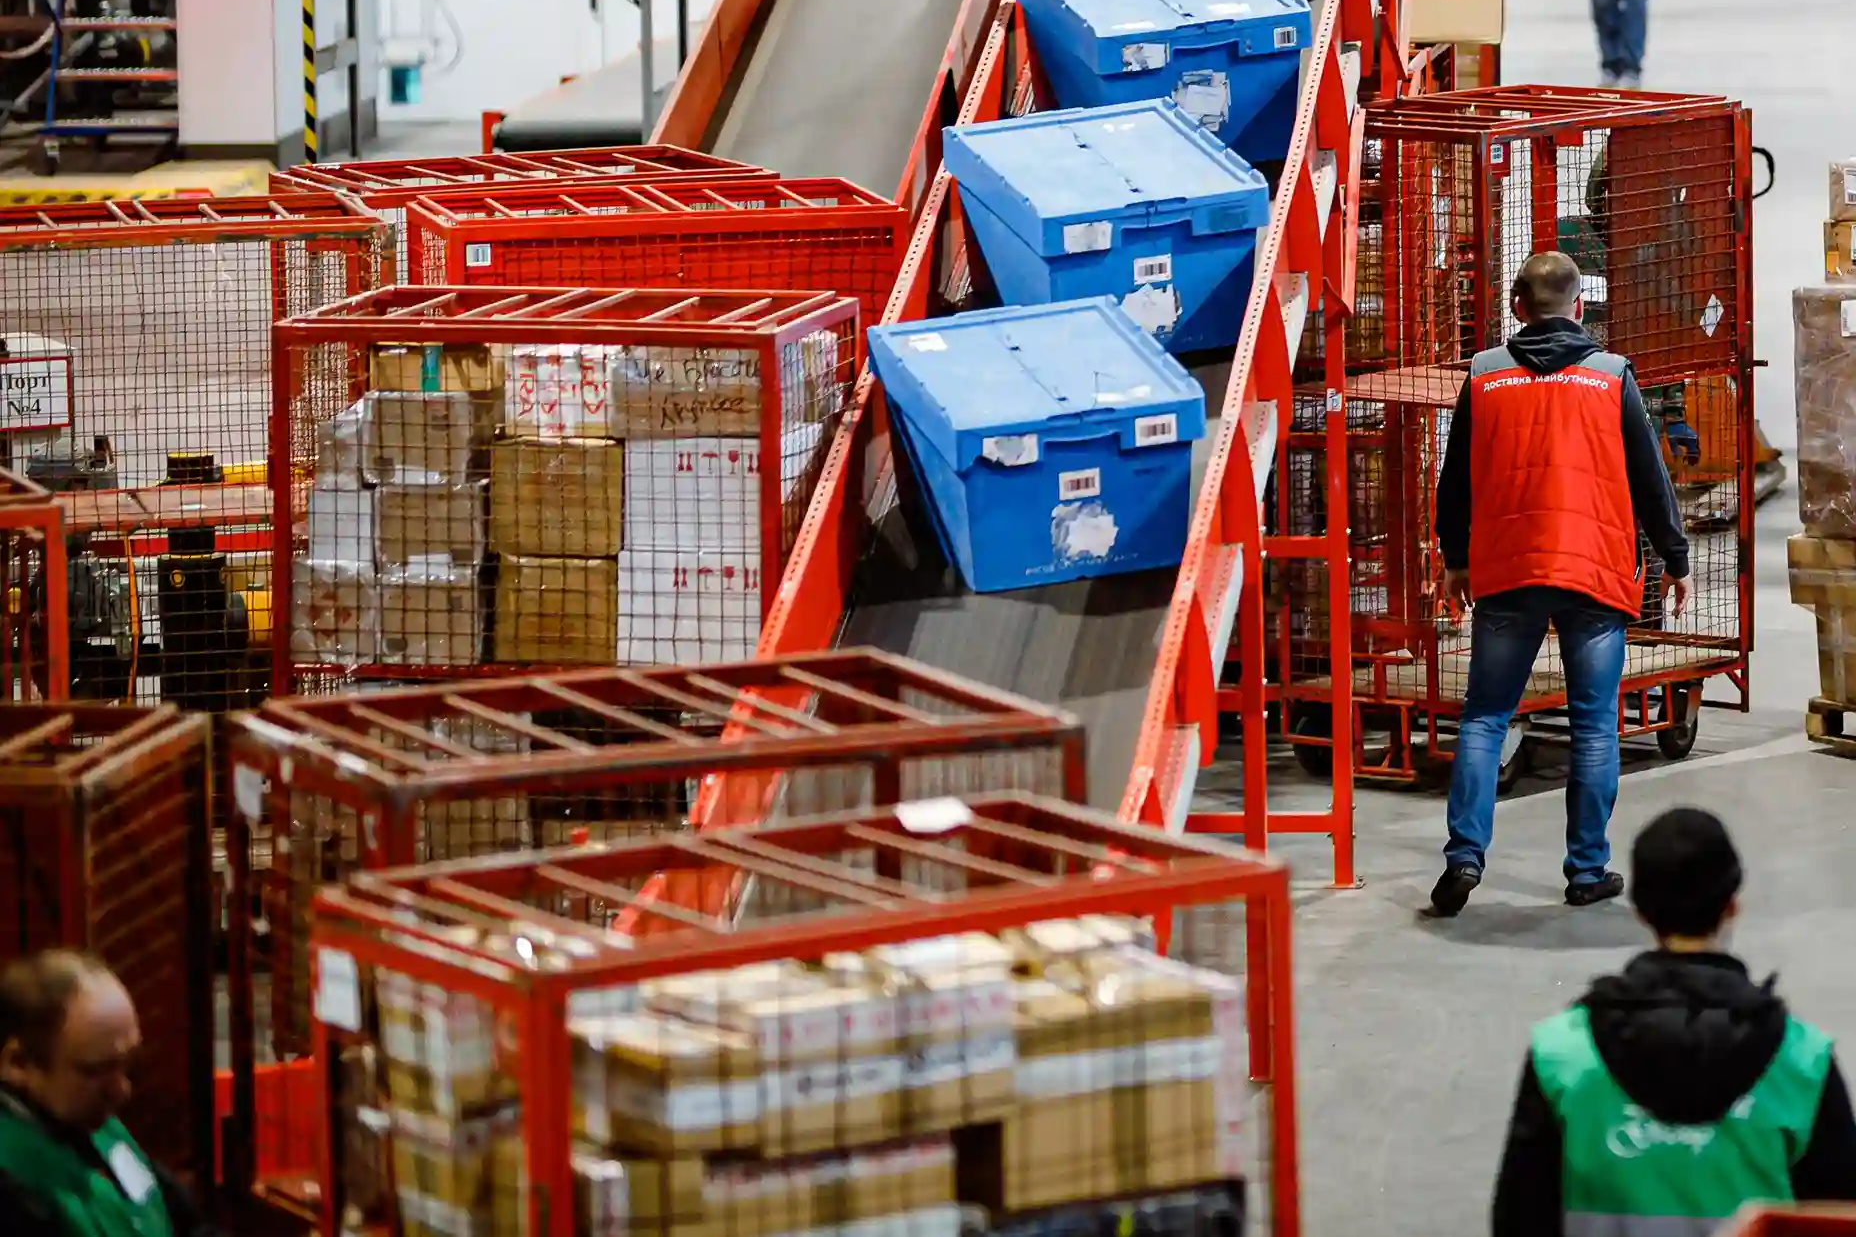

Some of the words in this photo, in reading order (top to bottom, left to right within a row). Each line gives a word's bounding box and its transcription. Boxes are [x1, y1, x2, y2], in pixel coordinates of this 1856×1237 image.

[0, 373, 48, 395] Порт
[1483, 376, 1532, 393] доставка
[1534, 373, 1609, 390] майбутнього
